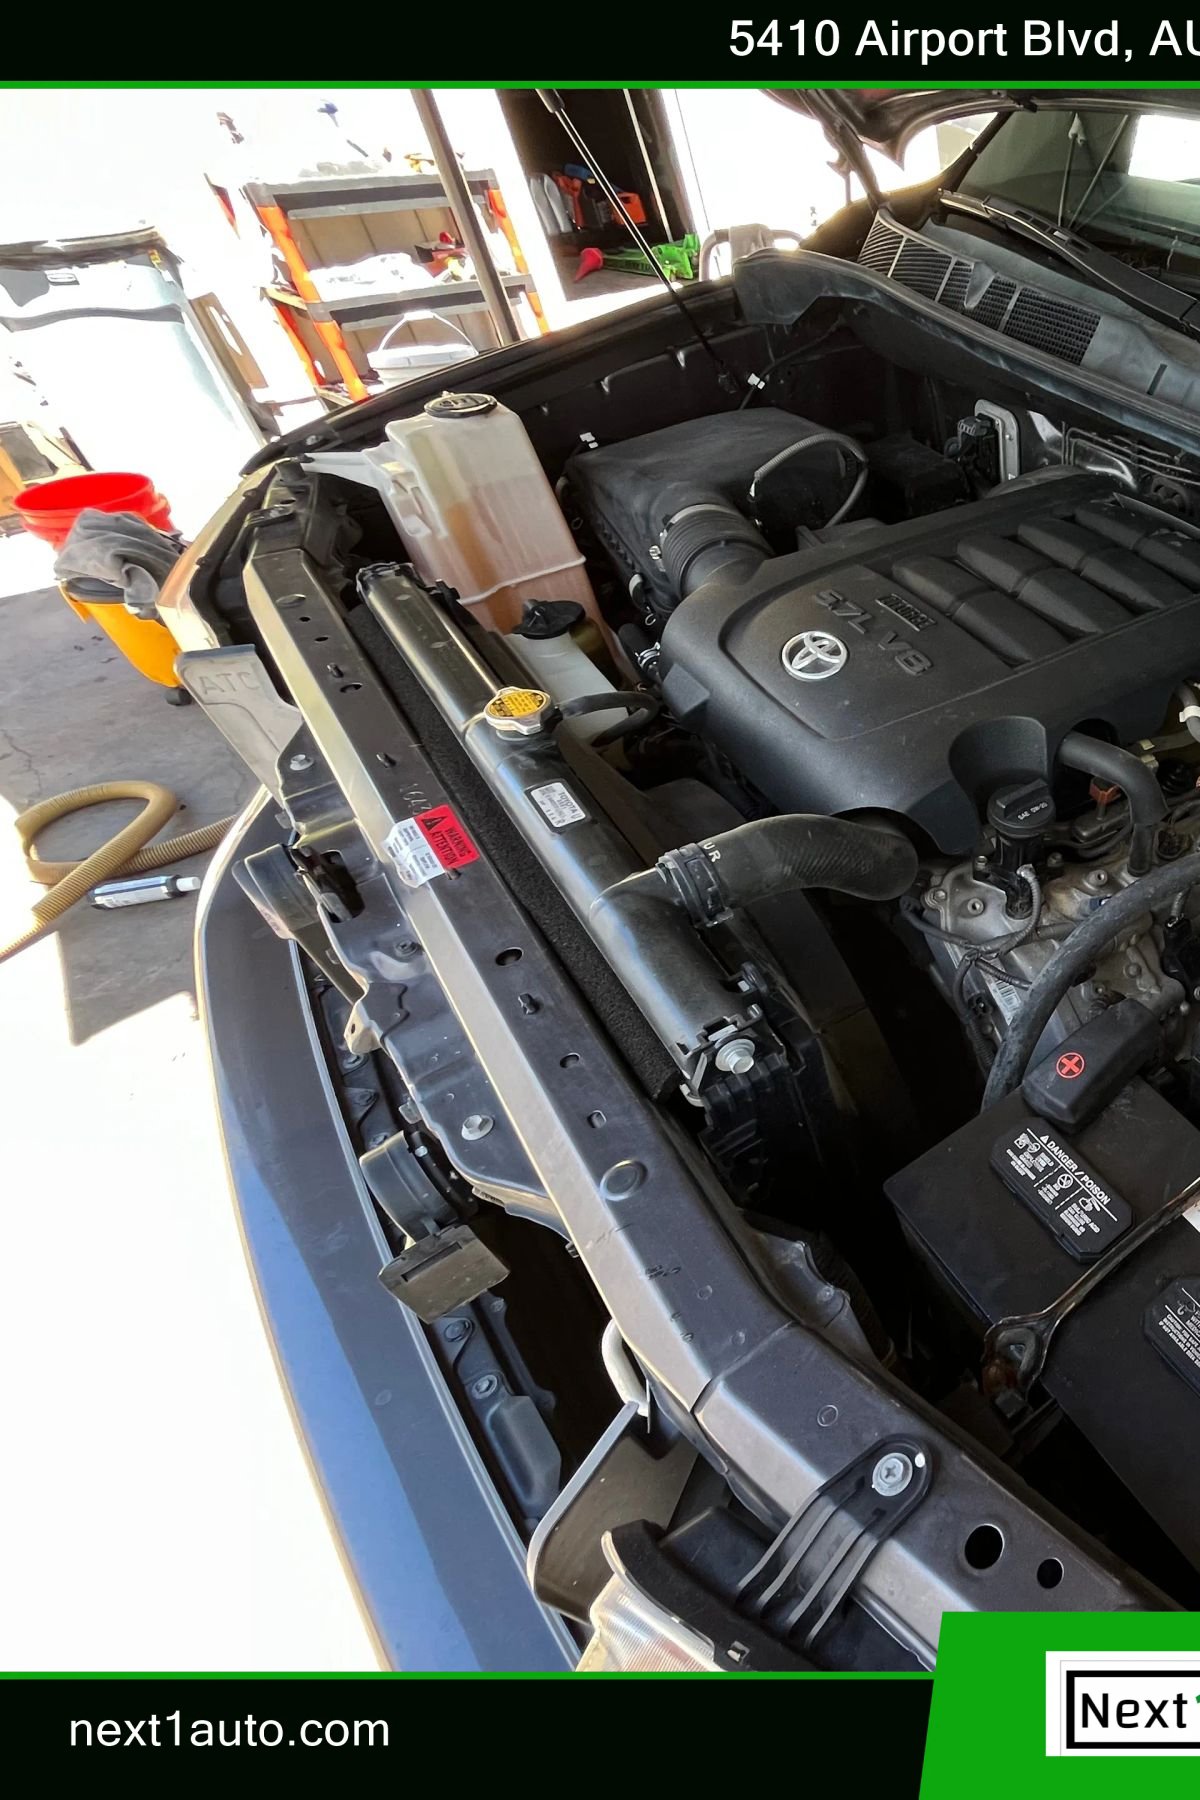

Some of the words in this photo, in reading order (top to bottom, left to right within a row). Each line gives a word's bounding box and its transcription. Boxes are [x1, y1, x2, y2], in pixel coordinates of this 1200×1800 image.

[878, 630, 933, 676] V8
[198, 671, 260, 695] ATC
[431, 830, 459, 866] ATTENTION
[445, 827, 473, 858] WARNING
[1046, 1140, 1079, 1172] DANGER
[1080, 1174, 1111, 1205] POISON
